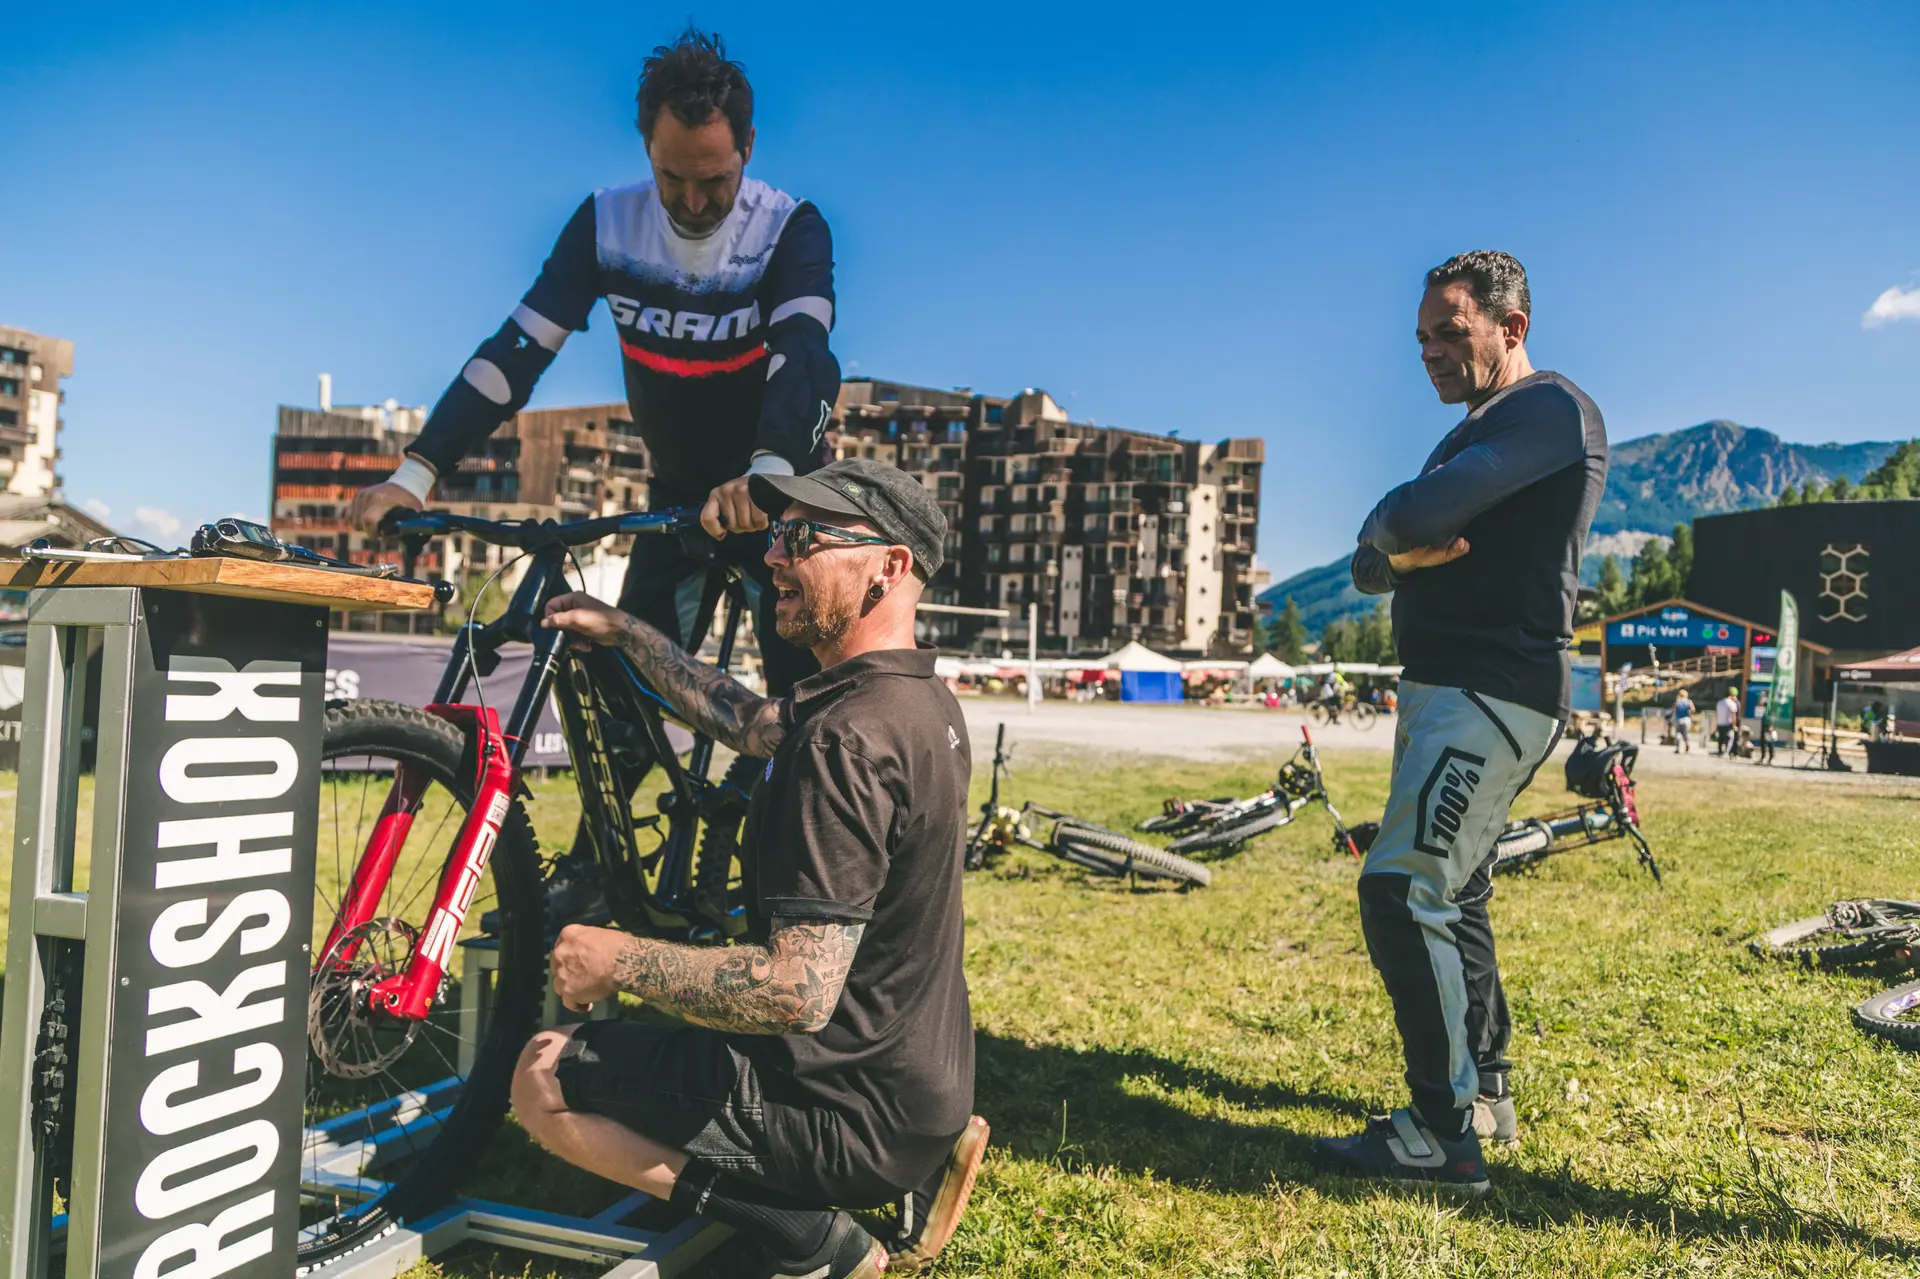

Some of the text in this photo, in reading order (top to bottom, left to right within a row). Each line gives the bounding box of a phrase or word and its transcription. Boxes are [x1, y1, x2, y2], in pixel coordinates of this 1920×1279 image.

[606, 293, 760, 341] SRAM
[1637, 624, 1688, 638] Pic Vert
[1430, 763, 1480, 845] 100%
[133, 655, 302, 1279] ROCKSHOX
